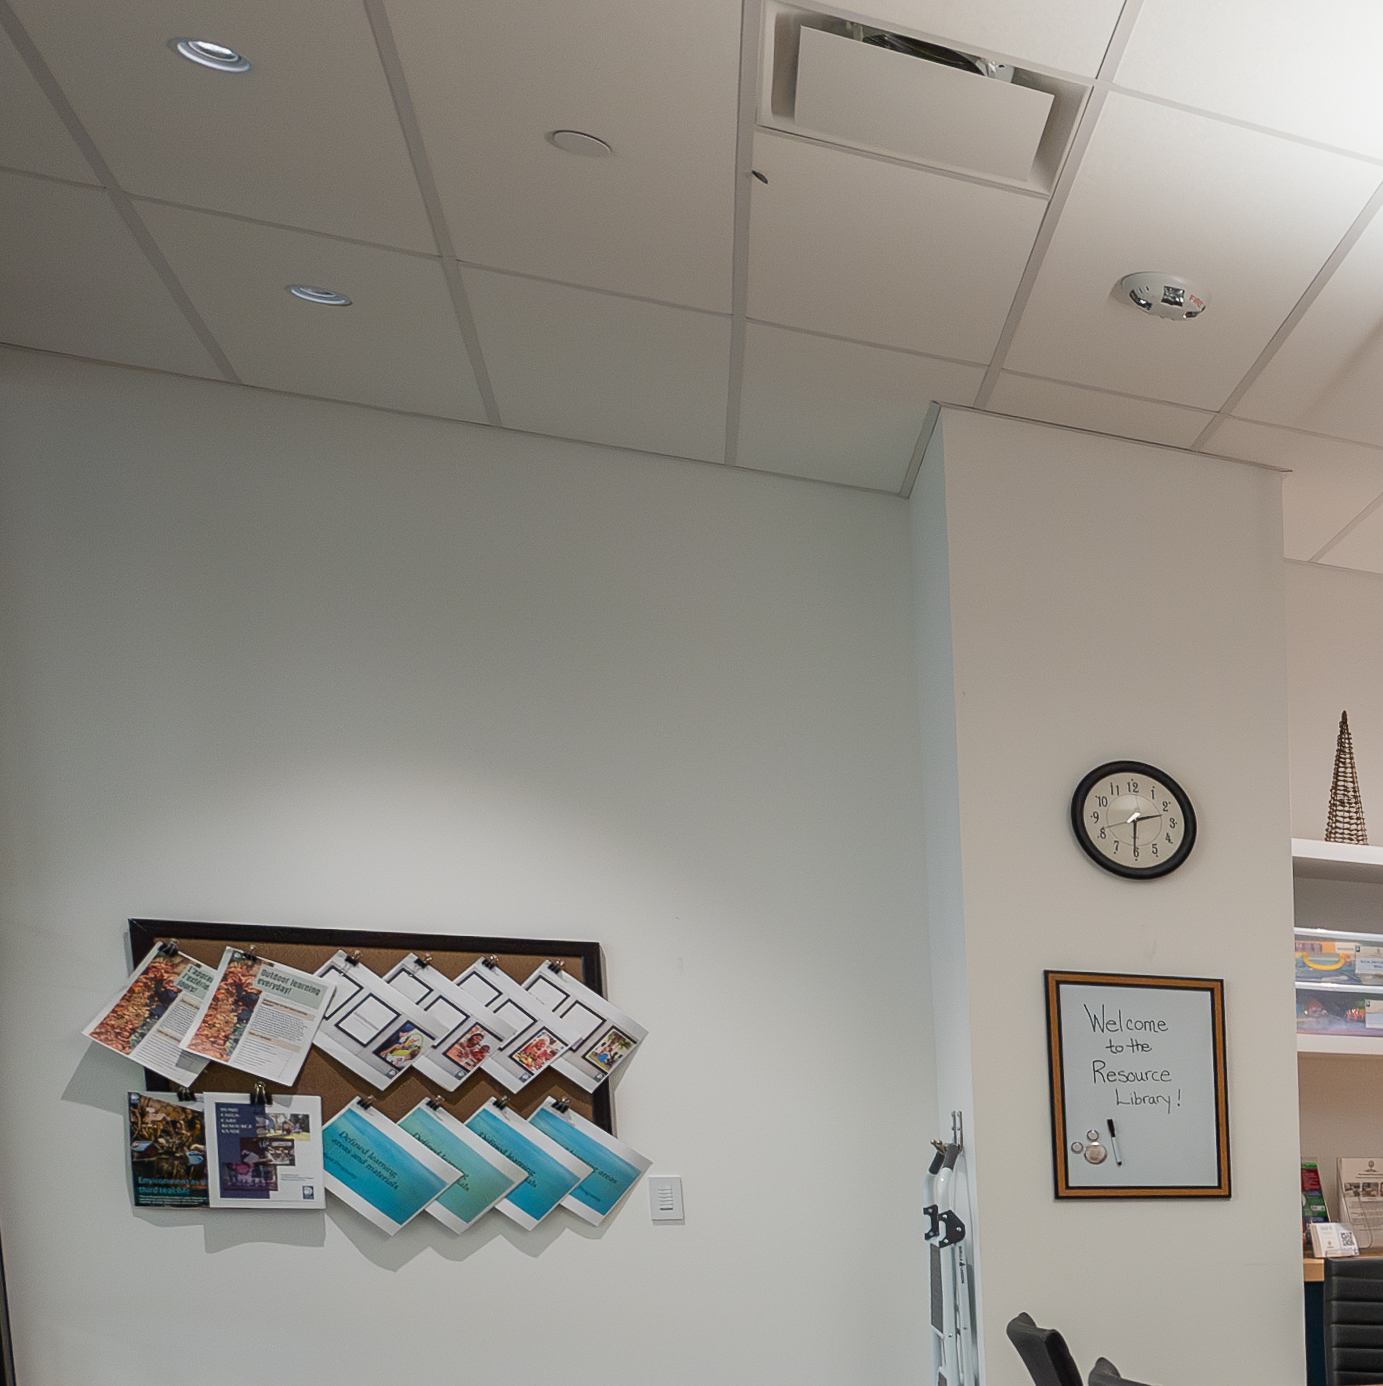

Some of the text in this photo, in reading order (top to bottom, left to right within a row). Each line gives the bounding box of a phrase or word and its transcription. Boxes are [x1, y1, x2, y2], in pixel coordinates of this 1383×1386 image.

[1110, 782, 1120, 796] 11
[1126, 781, 1139, 793] 12
[1150, 788, 1155, 800] 1
[1097, 796, 1108, 807] 10
[1162, 801, 1169, 812] 2
[1092, 811, 1099, 824] 9
[1169, 818, 1176, 829] 3
[1099, 827, 1107, 839] 8
[1165, 832, 1173, 844] 4
[1113, 840, 1120, 852] 7
[1151, 843, 1158, 855] 5
[1133, 847, 1140, 858] 6
[257, 977, 292, 995] everyday!
[289, 977, 321, 996] learning
[1083, 1003, 1169, 1033] Welcome
[1105, 1037, 1153, 1054] to the
[1092, 1059, 1172, 1084] Resource
[338, 1130, 370, 1155] Defined
[367, 1151, 399, 1179] learning
[331, 1138, 351, 1155] areas
[351, 1151, 367, 1165] and
[365, 1162, 399, 1191] materials
[138, 1176, 189, 1186] Environment
[598, 1168, 618, 1184] areas
